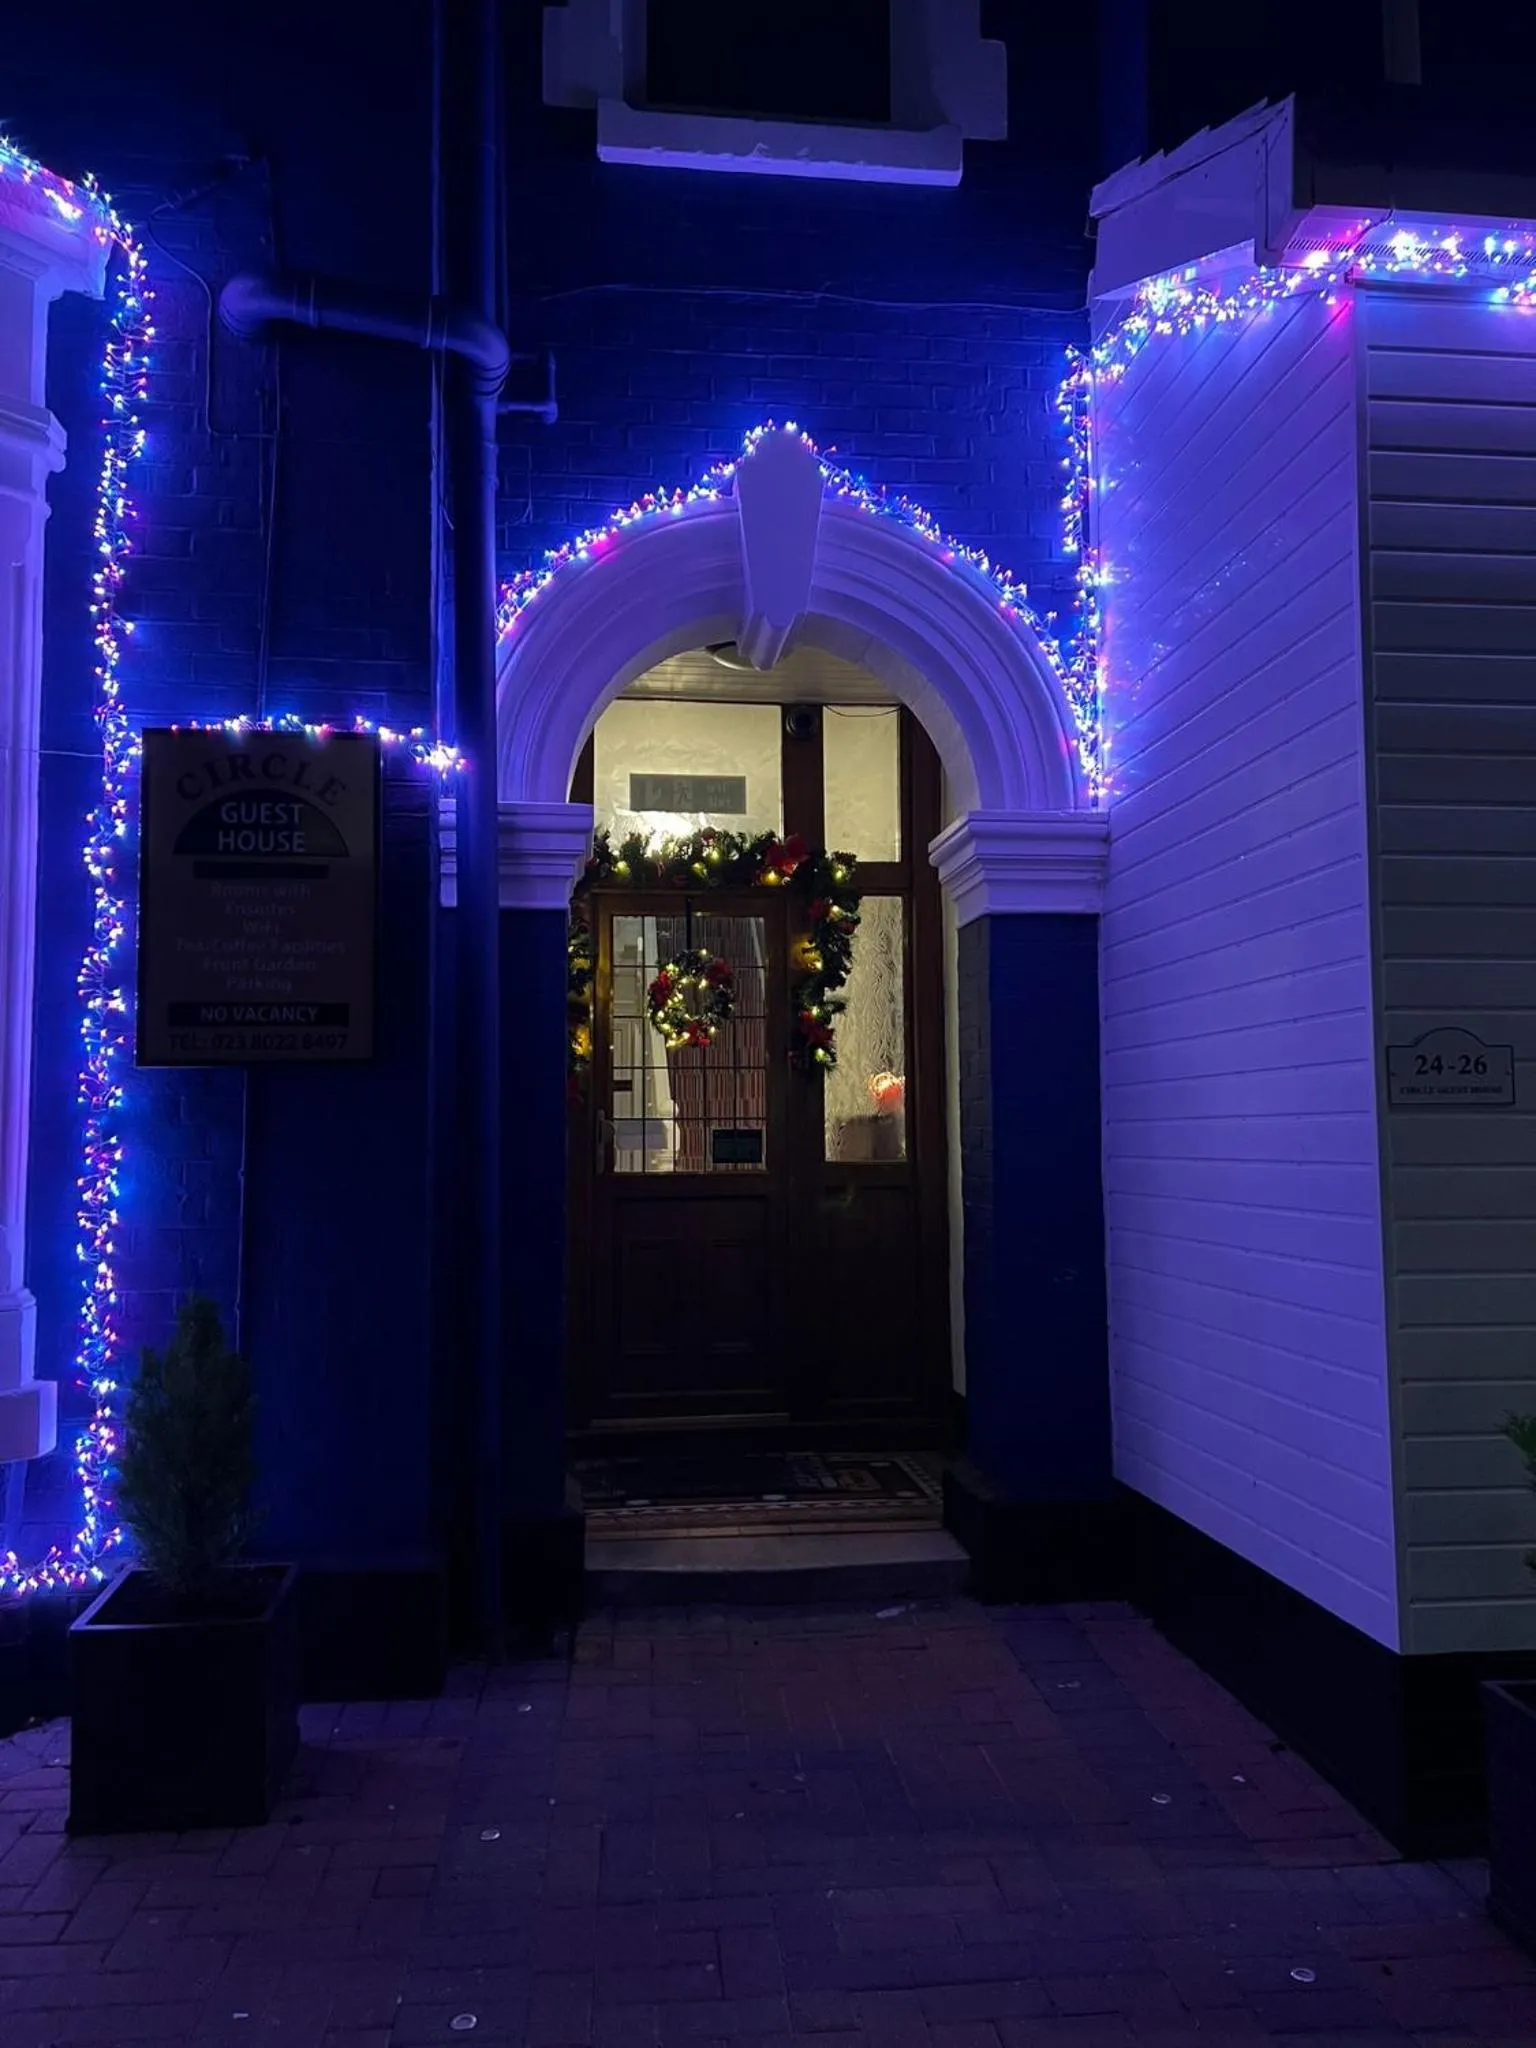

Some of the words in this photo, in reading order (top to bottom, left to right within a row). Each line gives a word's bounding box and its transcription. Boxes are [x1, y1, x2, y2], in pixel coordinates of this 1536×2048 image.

[176, 751, 348, 806] CIRCLE
[220, 801, 305, 825] GUEST
[218, 829, 307, 854] HOUSE
[226, 974, 293, 994] Parking
[200, 1005, 228, 1022] NO
[232, 1005, 319, 1023] VACANCY
[1414, 1054, 1488, 1076] 24-26
